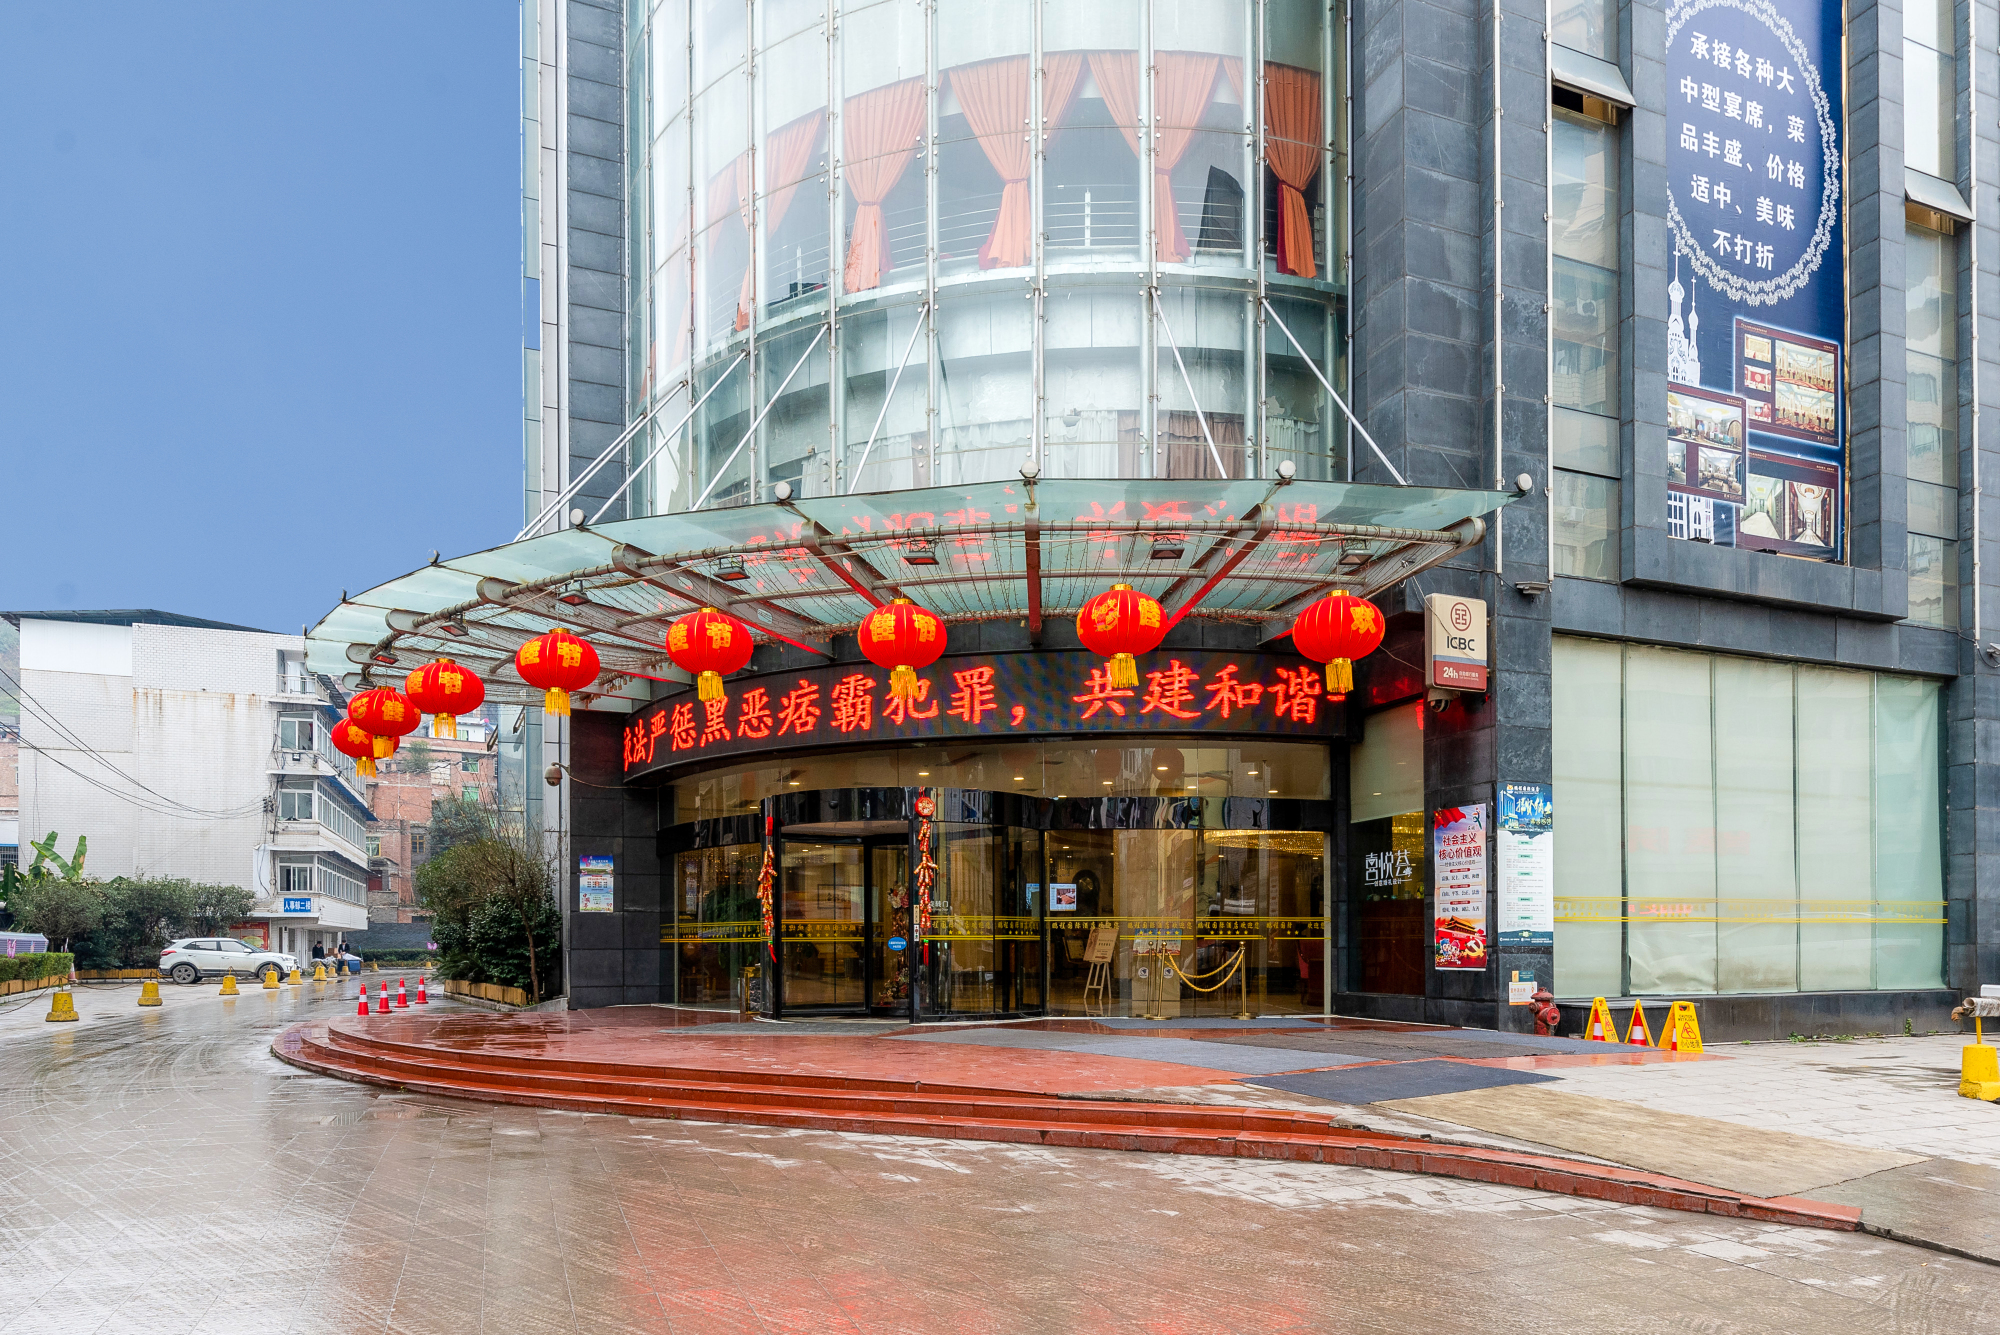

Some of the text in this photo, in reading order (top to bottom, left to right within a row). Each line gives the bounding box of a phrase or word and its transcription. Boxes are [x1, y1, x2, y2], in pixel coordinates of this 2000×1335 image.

[1690, 31, 1795, 95] 承接各种大
[1690, 174, 1795, 231] 适中、美味
[1712, 228, 1775, 271] 不打折
[1447, 636, 1475, 651] ICBC
[1443, 666, 1458, 679] 24h
[1443, 832, 1477, 846] 社会主义
[1439, 846, 1482, 860] 核心价值观
